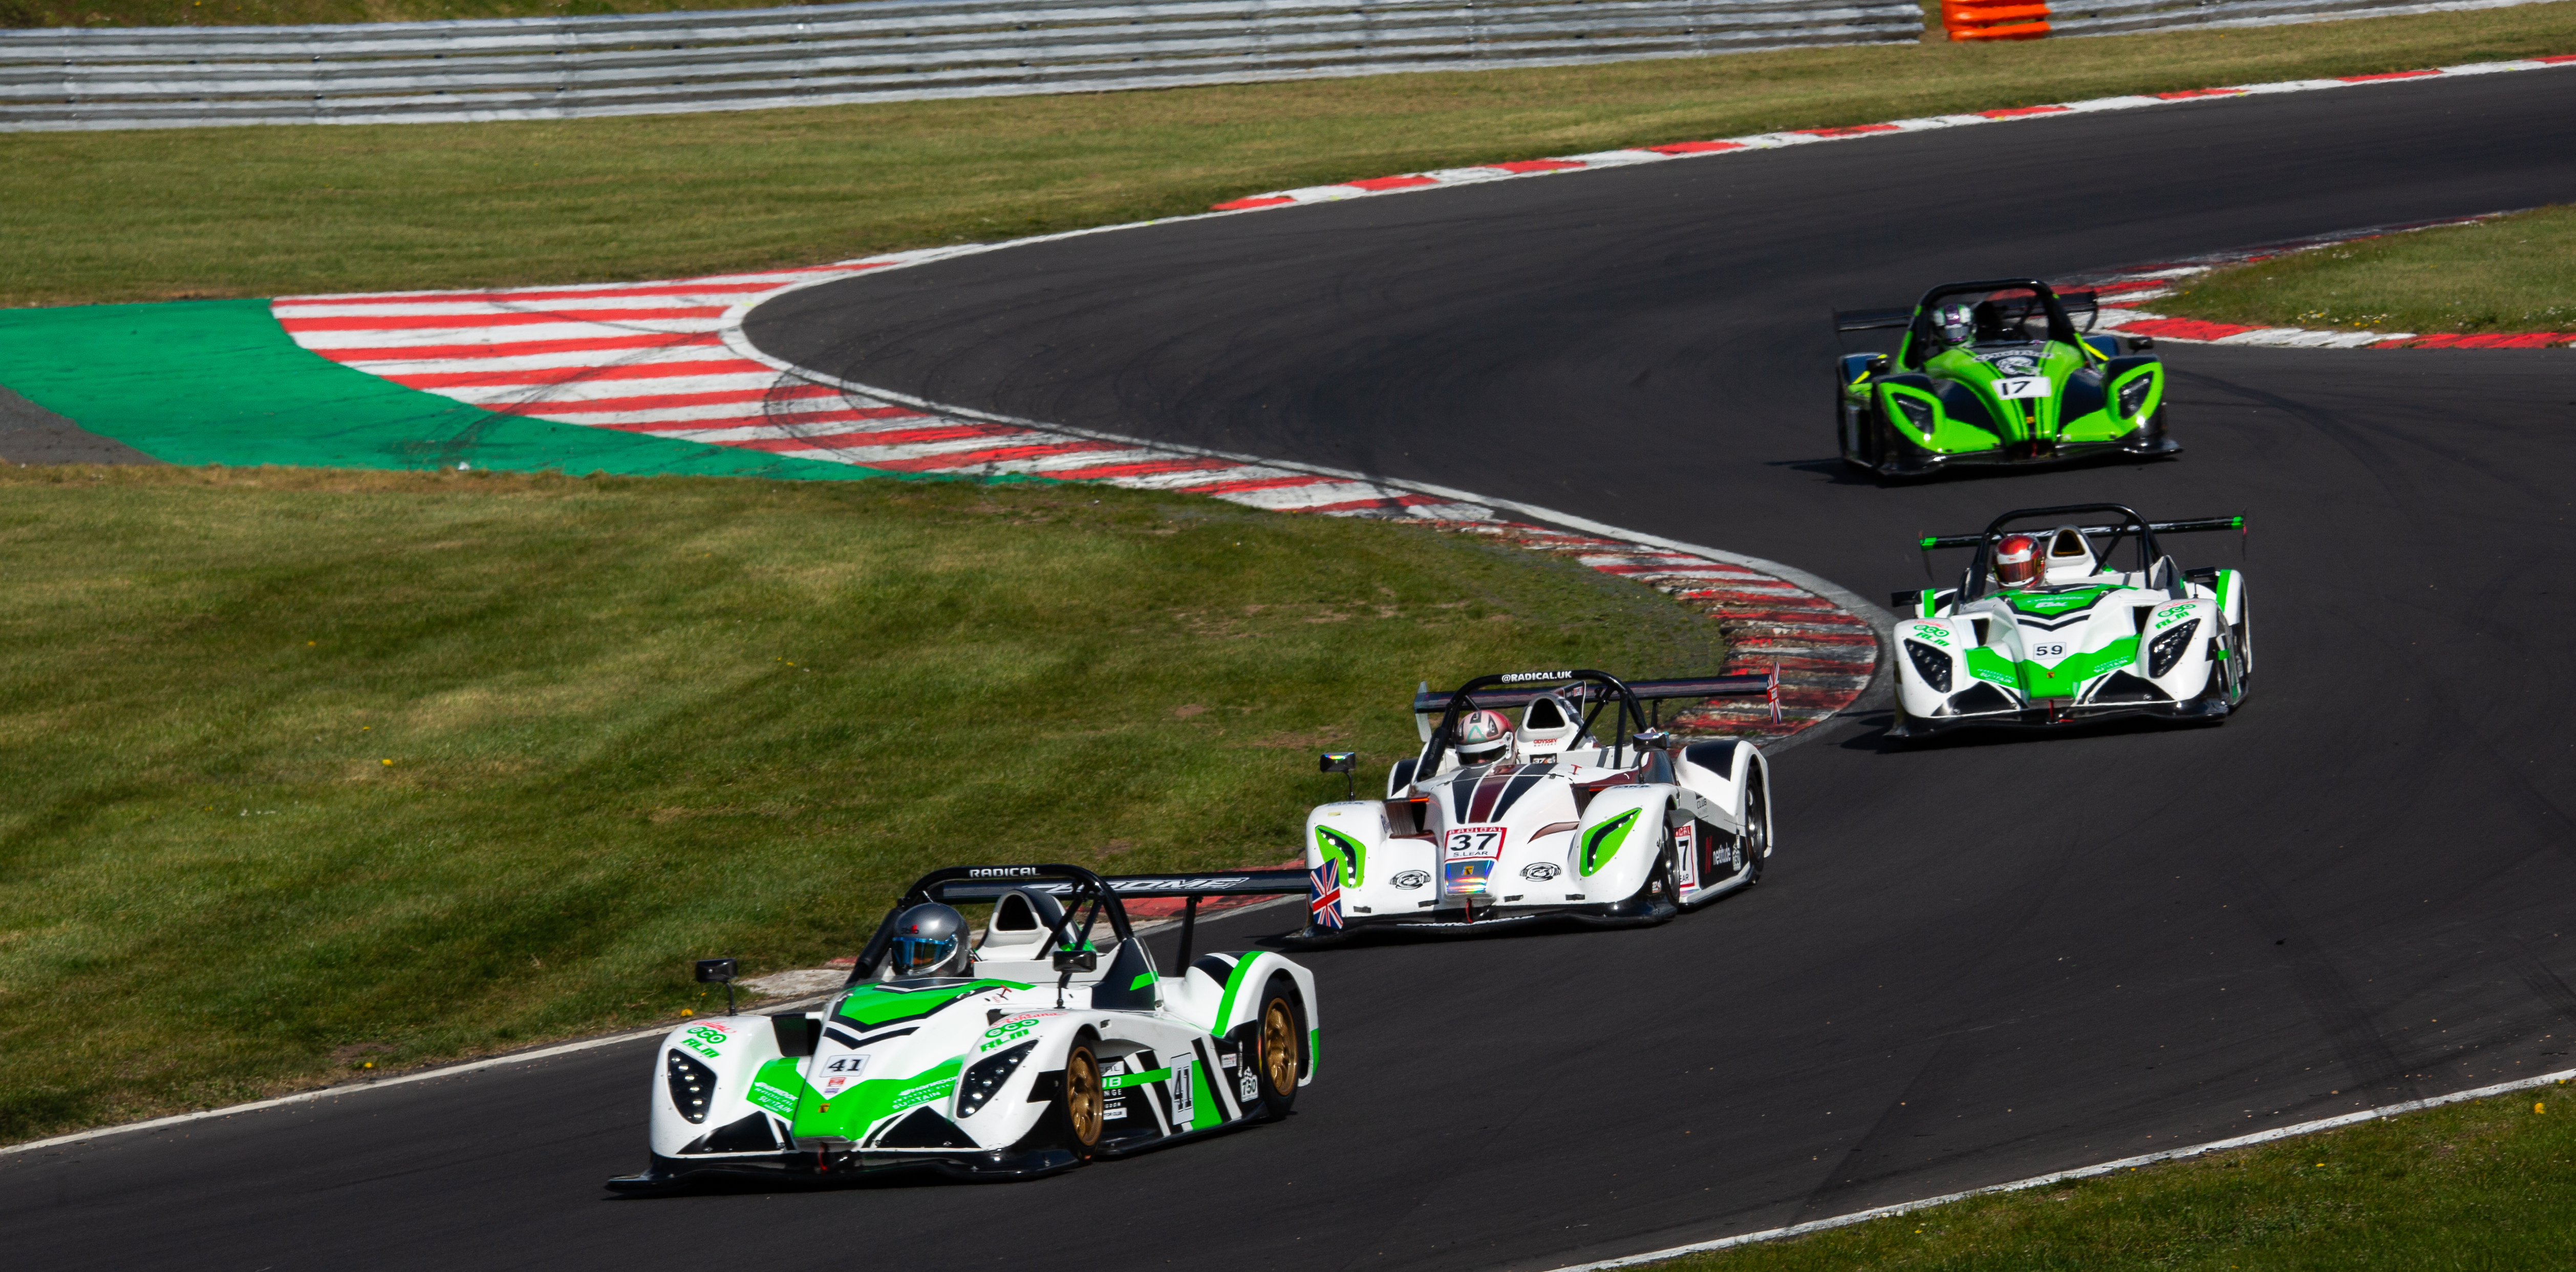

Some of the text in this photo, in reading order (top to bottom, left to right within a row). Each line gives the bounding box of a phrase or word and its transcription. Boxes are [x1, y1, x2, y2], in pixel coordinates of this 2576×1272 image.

[2003, 381, 2030, 395] 17
[2036, 645, 2063, 656] 59
[1501, 670, 1572, 683] @RADICAL.UK
[1450, 833, 1498, 851] 37
[1678, 840, 1689, 871] 7
[969, 867, 1041, 877] RADICAL
[828, 1059, 861, 1072] 41
[1174, 1066, 1193, 1113] 41
[1242, 1079, 1256, 1095] 750
